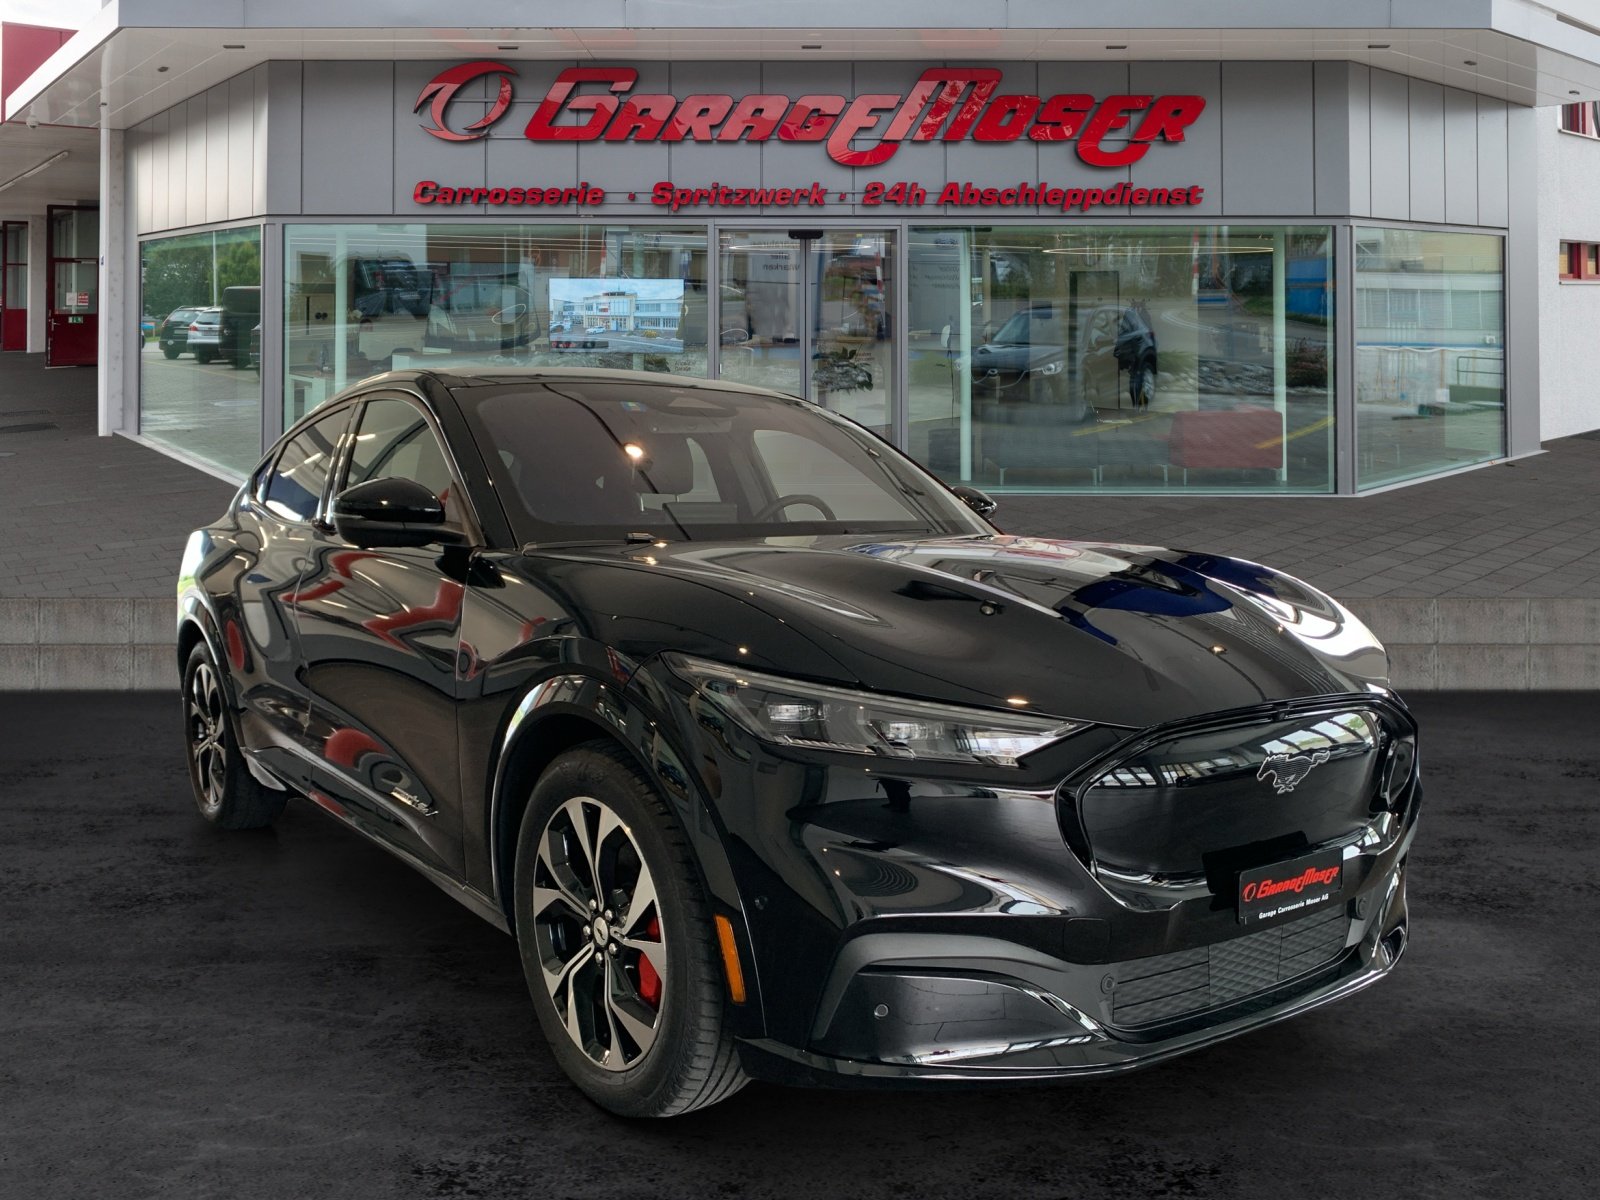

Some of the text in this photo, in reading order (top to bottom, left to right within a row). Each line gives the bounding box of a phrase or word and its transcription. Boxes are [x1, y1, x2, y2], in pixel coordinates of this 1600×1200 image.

[413, 181, 1204, 212] Carrosserie Spritzwerk 24h Abschleppdienst
[1259, 893, 1329, 919] Garage Carrosserie Moser AG
